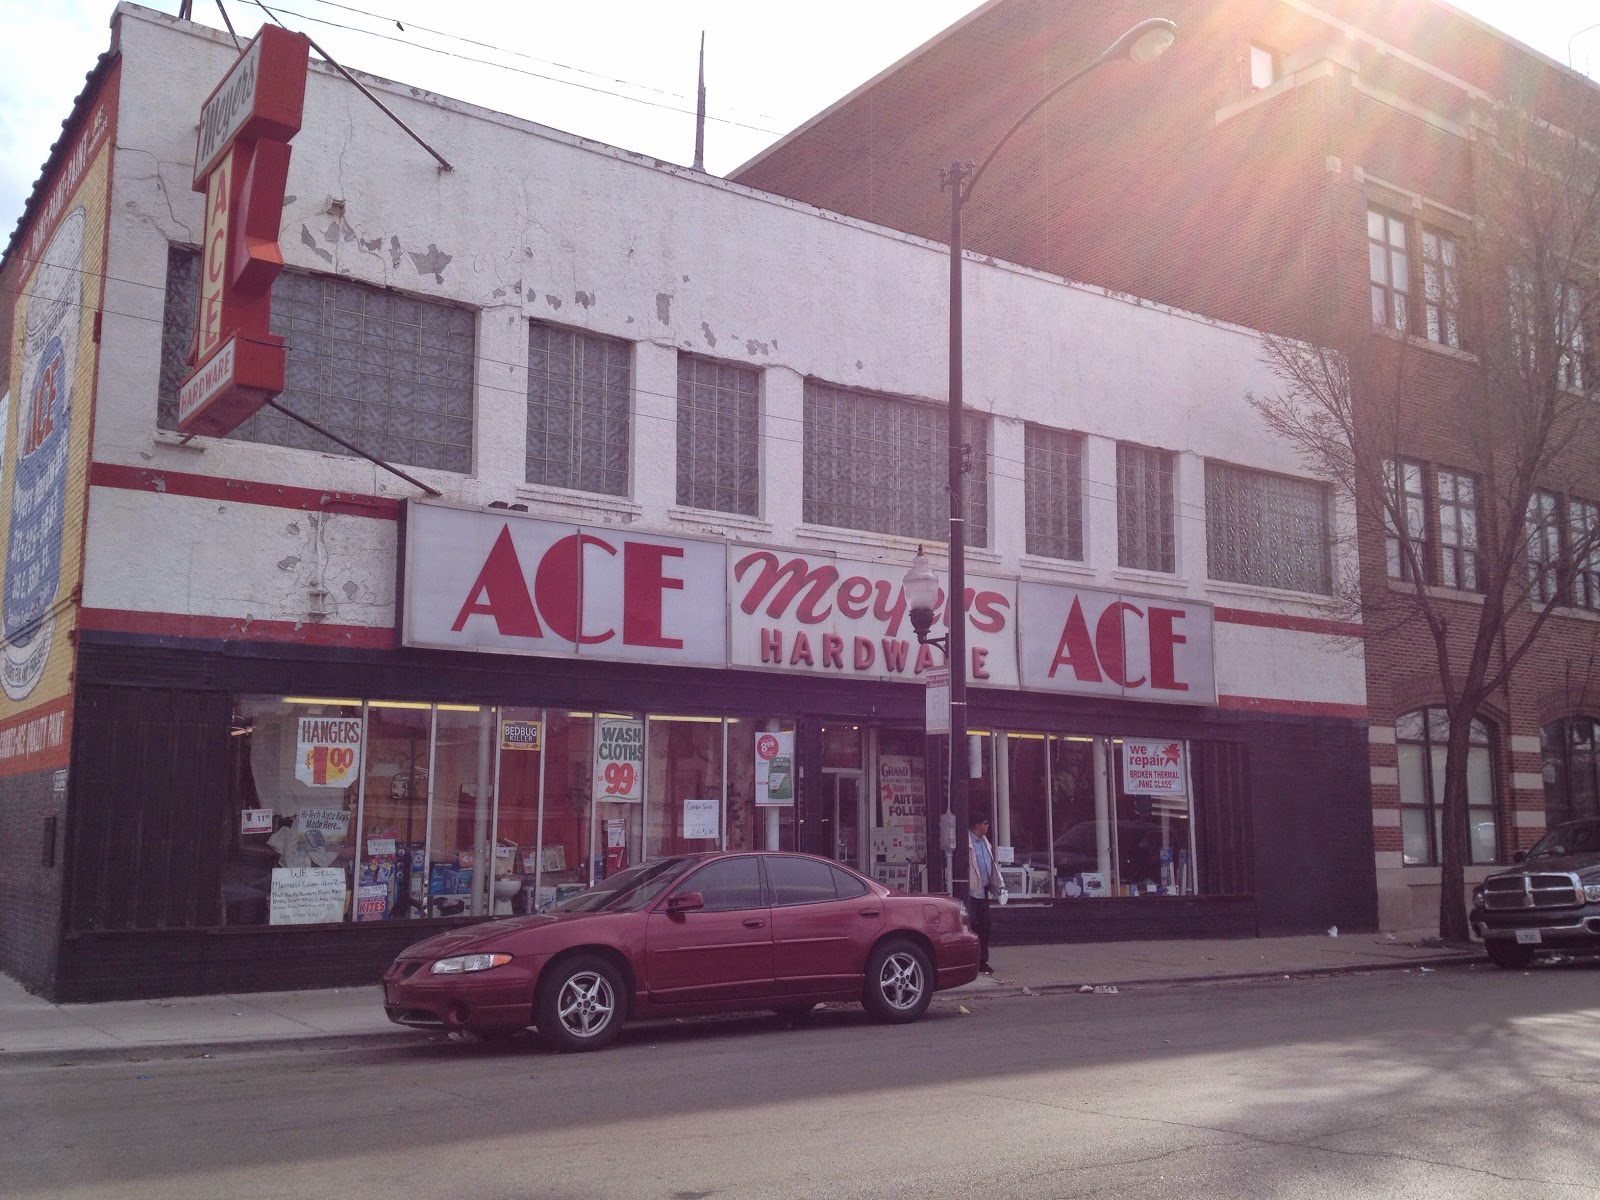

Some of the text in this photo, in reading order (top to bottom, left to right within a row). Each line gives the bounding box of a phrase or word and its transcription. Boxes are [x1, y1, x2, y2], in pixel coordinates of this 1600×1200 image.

[201, 55, 255, 162] Meyers
[204, 168, 227, 351] ACE
[180, 350, 232, 415] HARDWARE
[24, 353, 60, 458] ACE
[450, 522, 684, 650] ACE
[734, 551, 1011, 637] Meyrs
[1047, 593, 1190, 692] ACE
[760, 627, 991, 680] HARDWAE
[301, 720, 360, 743] HANGERS
[505, 726, 537, 736] BEDBUG
[601, 726, 642, 743] WASH
[598, 742, 645, 762] CLOTHS
[1129, 745, 1147, 755] we
[1129, 754, 1165, 769] repair
[1129, 770, 1180, 779] BROKEN THERMAL
[1138, 780, 1172, 789] PANE GLASS
[300, 809, 321, 819] Hi-Tech
[321, 811, 336, 820] Auto
[888, 805, 926, 817] FOLLIES
[305, 819, 323, 829] Made
[290, 868, 307, 878] WE
[358, 900, 386, 914] KITES
